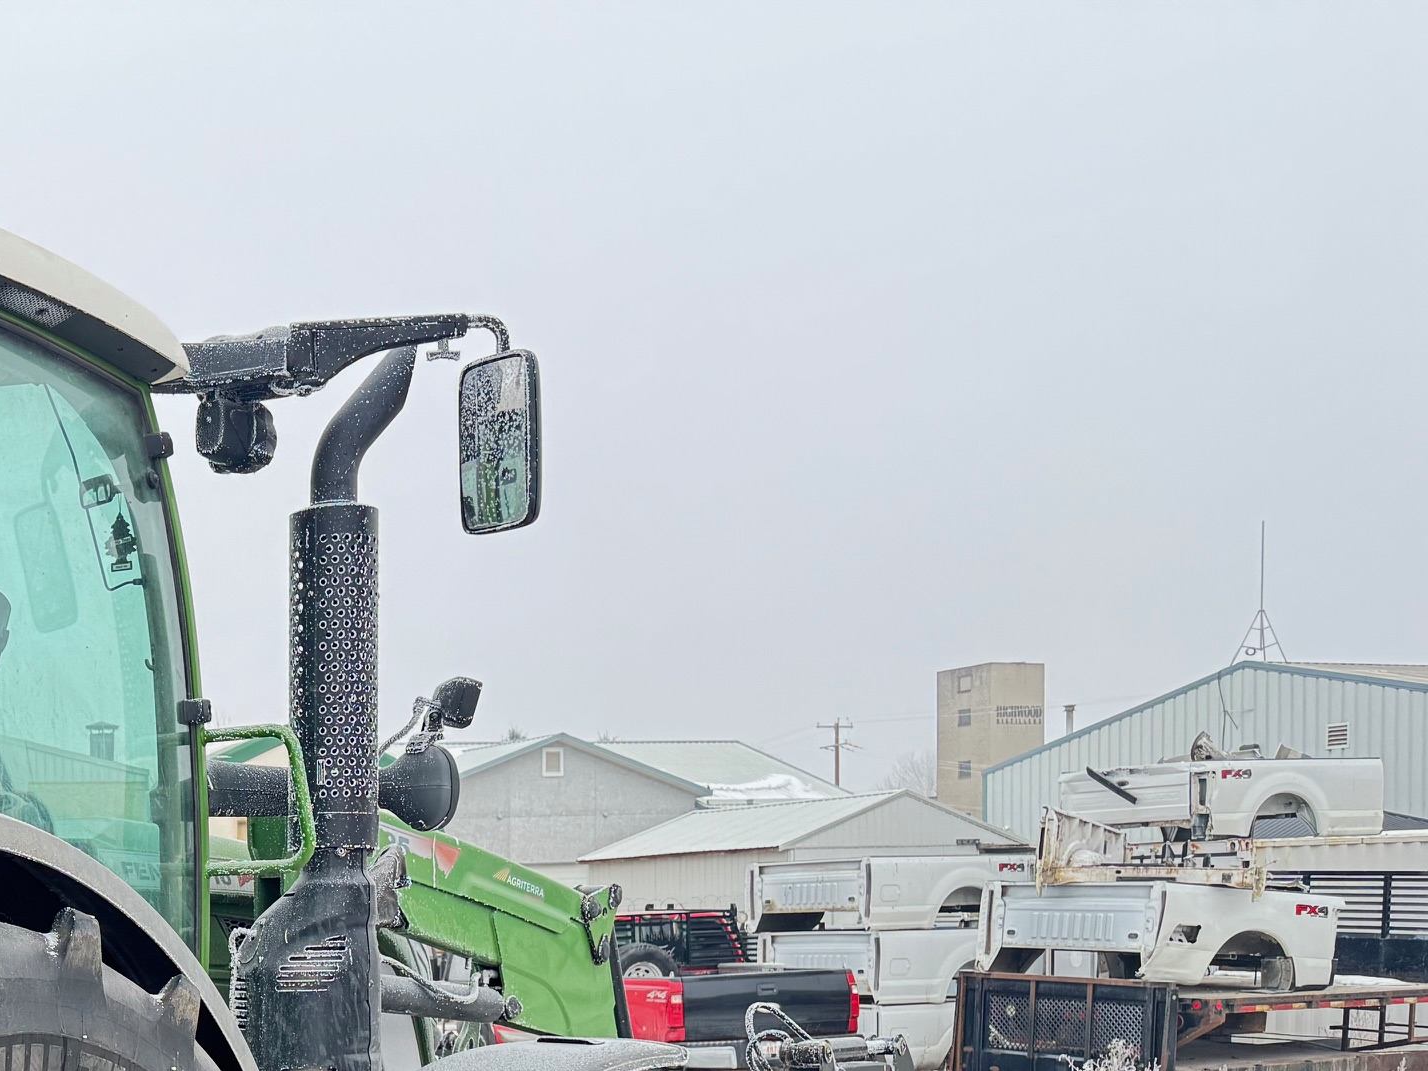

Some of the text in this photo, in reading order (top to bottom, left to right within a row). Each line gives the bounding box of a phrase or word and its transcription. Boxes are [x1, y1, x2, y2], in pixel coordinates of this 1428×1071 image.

[1221, 769, 1252, 779] FX4
[998, 863, 1025, 872] FX4
[506, 875, 544, 898] AGRITERRA
[1295, 904, 1329, 918] FX4
